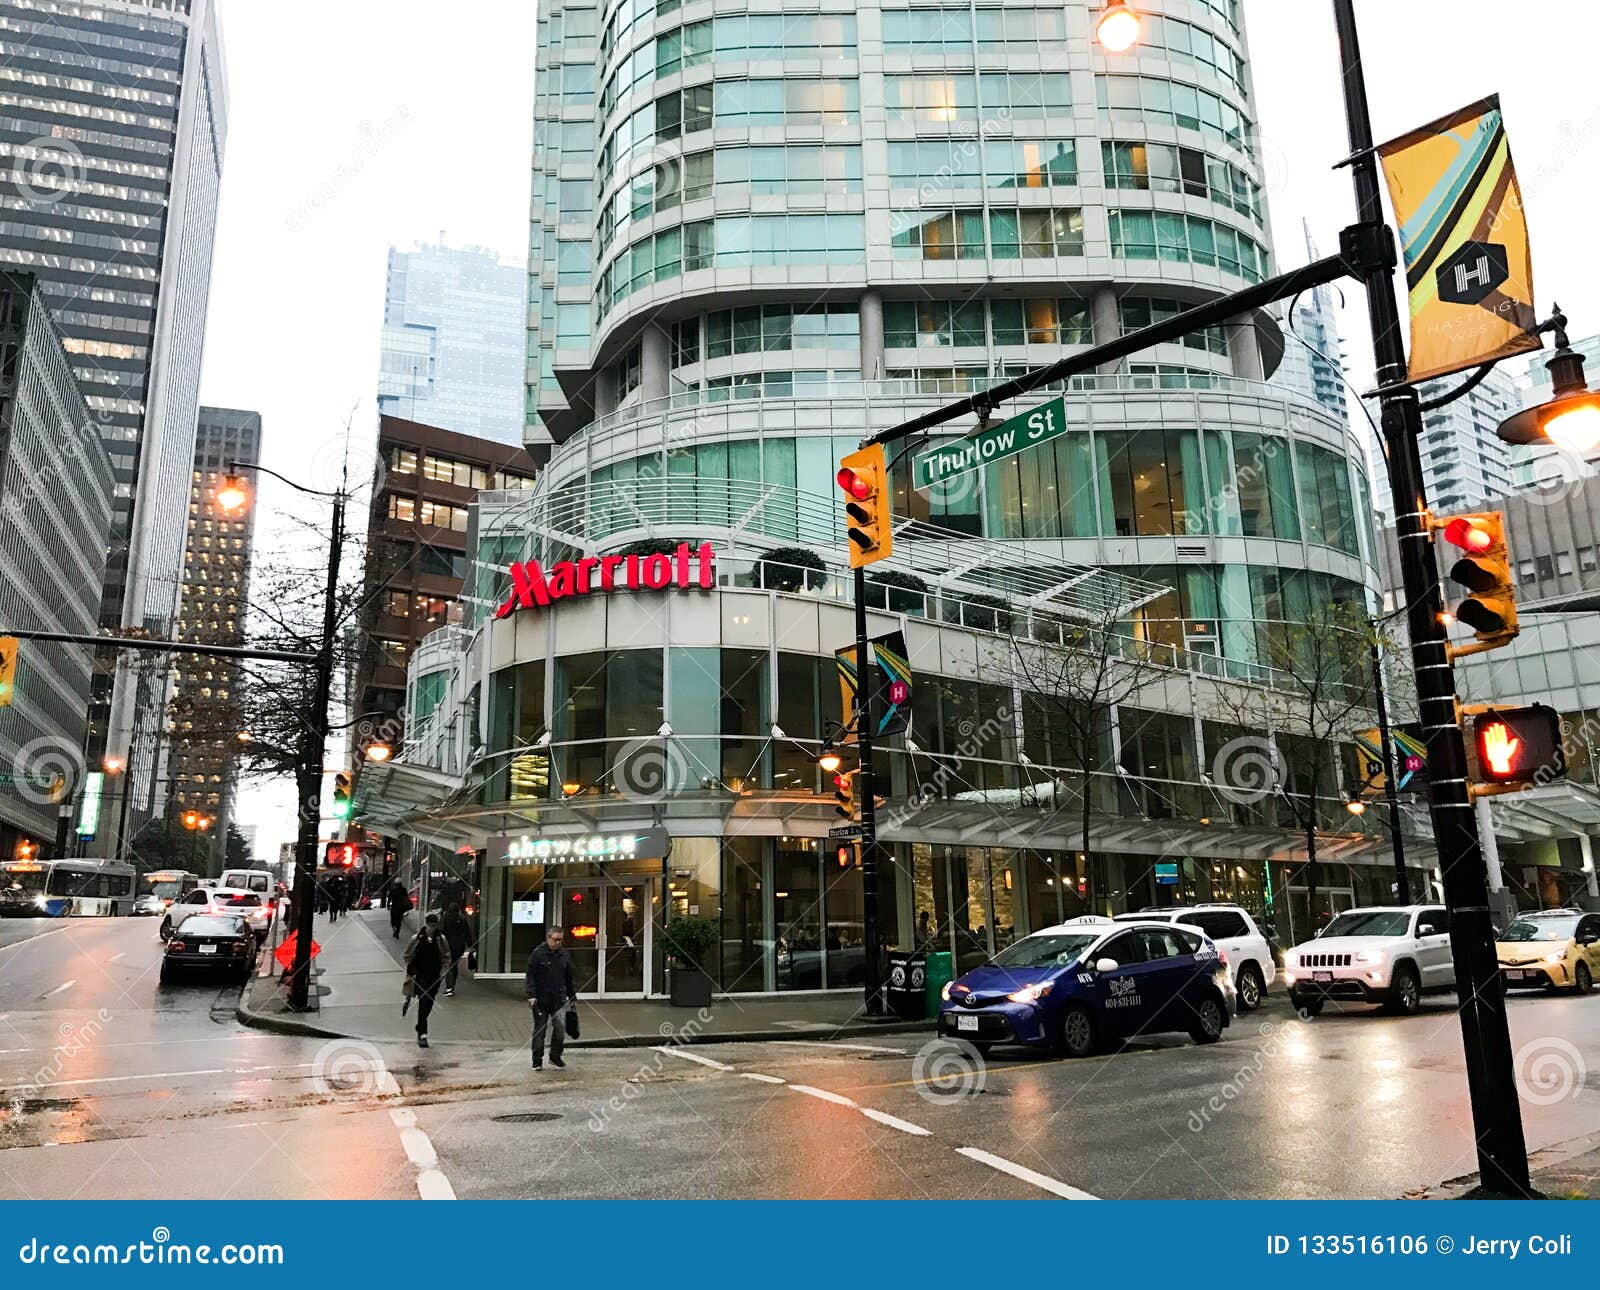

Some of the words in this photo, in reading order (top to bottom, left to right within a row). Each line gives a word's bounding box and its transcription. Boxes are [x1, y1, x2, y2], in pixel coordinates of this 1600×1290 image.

[1454, 255, 1490, 293] H
[922, 429, 1016, 479] Thurlow
[1027, 408, 1056, 439] St
[496, 541, 716, 619] Marriott
[894, 686, 903, 699] H
[1409, 759, 1419, 769] H
[507, 834, 637, 859] showcase
[509, 855, 595, 866] RESTAURANT
[609, 853, 636, 861] BAR
